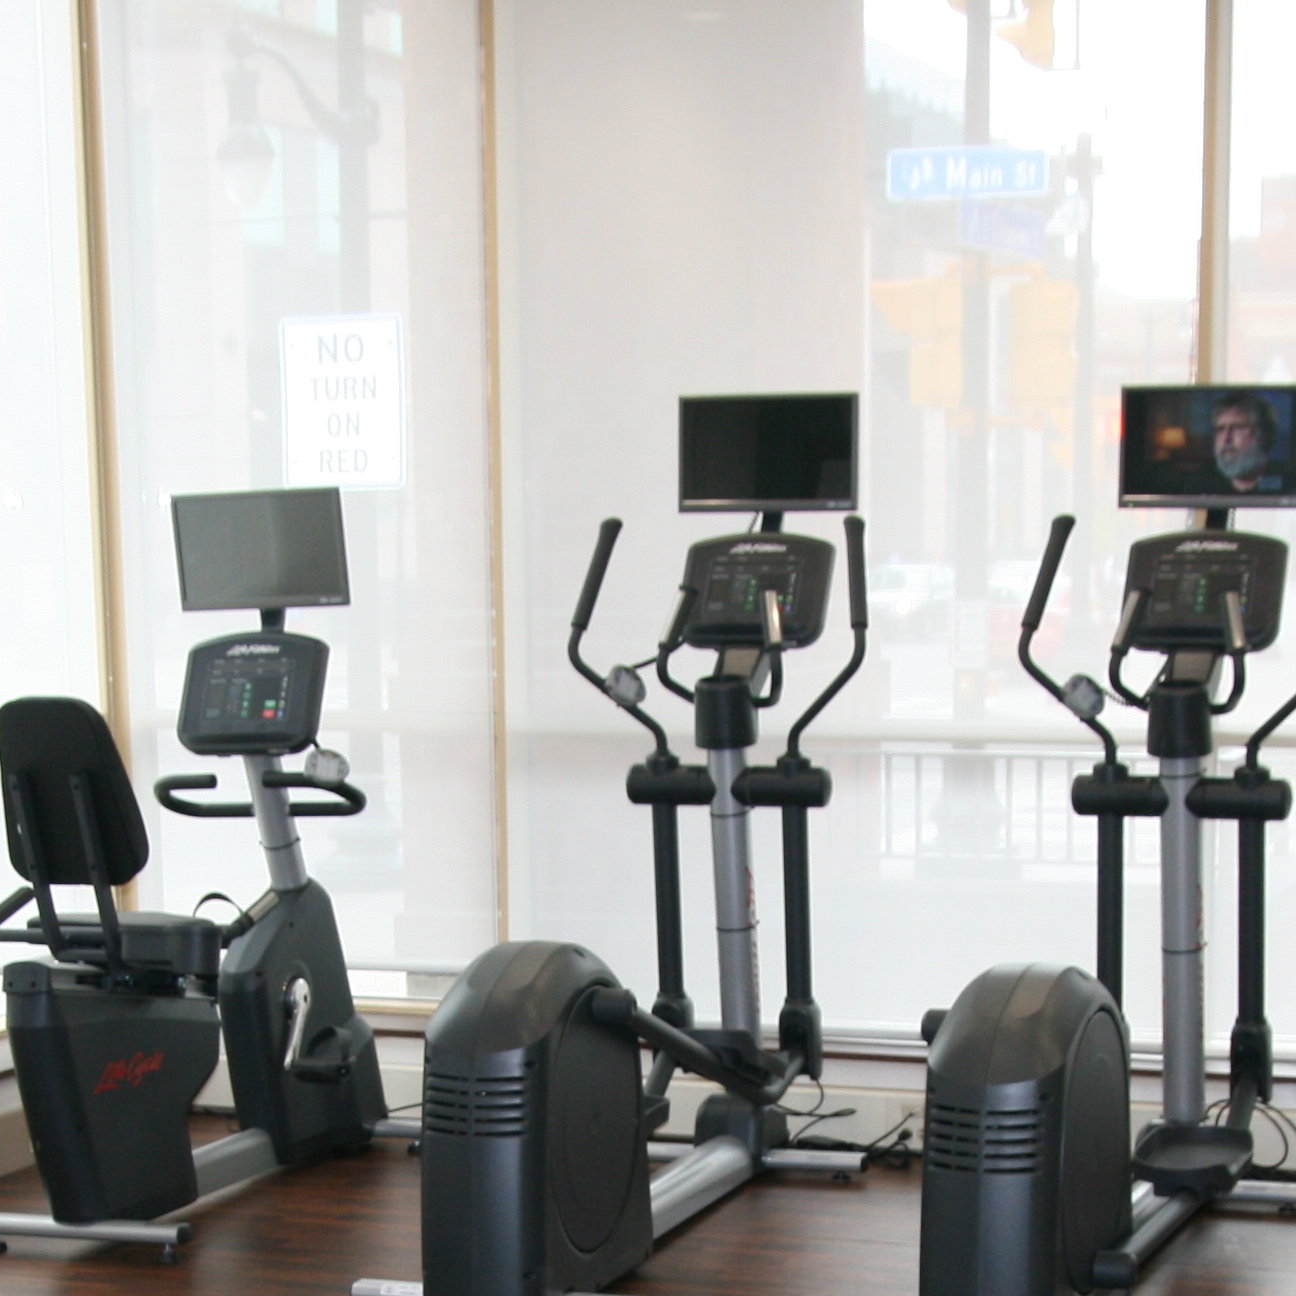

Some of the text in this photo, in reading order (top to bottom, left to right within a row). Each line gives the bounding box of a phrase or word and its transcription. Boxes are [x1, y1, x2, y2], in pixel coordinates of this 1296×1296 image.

[946, 154, 1037, 191] Main St
[317, 333, 365, 364] NO
[309, 375, 377, 401] TURN
[327, 412, 360, 438] ON
[319, 449, 368, 473] RED
